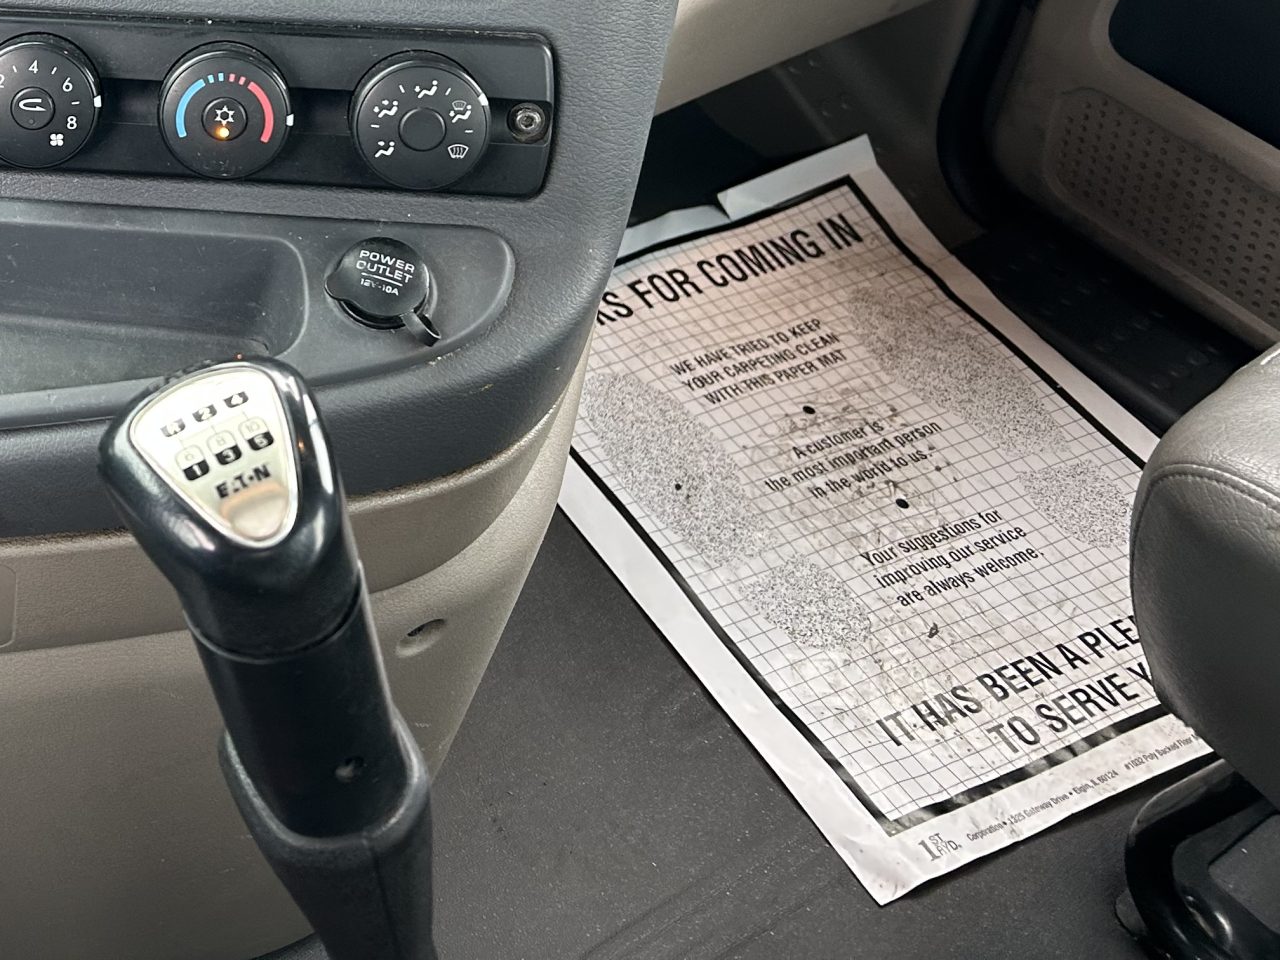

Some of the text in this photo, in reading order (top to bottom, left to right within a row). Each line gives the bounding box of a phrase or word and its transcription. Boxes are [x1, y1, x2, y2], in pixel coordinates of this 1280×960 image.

[28, 59, 39, 74] 4
[62, 77, 73, 92] 6
[66, 115, 78, 130] 8
[355, 260, 413, 283] OUTLET
[359, 249, 415, 273] POWER
[627, 268, 703, 310] FOR
[696, 229, 826, 288] COMING
[817, 213, 864, 251] IN
[670, 318, 822, 377] WE HAVE TRIED TO KEEP
[681, 332, 841, 392] YOUR CARPETING CLEAN
[704, 348, 848, 405] WITH THIS PAPER MAT
[764, 421, 942, 493] the most important person
[792, 419, 885, 460] A customer is
[808, 448, 933, 499] in the world to us.
[859, 509, 1003, 567] Your suggestions for
[873, 525, 1028, 589] improving our service
[896, 546, 1045, 608] are always welcome.
[875, 710, 917, 747] IT
[910, 684, 984, 732] HAS
[976, 650, 1064, 703] BEEN
[1055, 642, 1091, 670] A
[986, 714, 1042, 755] TO
[1034, 671, 1140, 735] SERVE
[966, 821, 1003, 842] Corporation
[1023, 800, 1054, 818] Gateway
[1050, 792, 1070, 805] Drive
